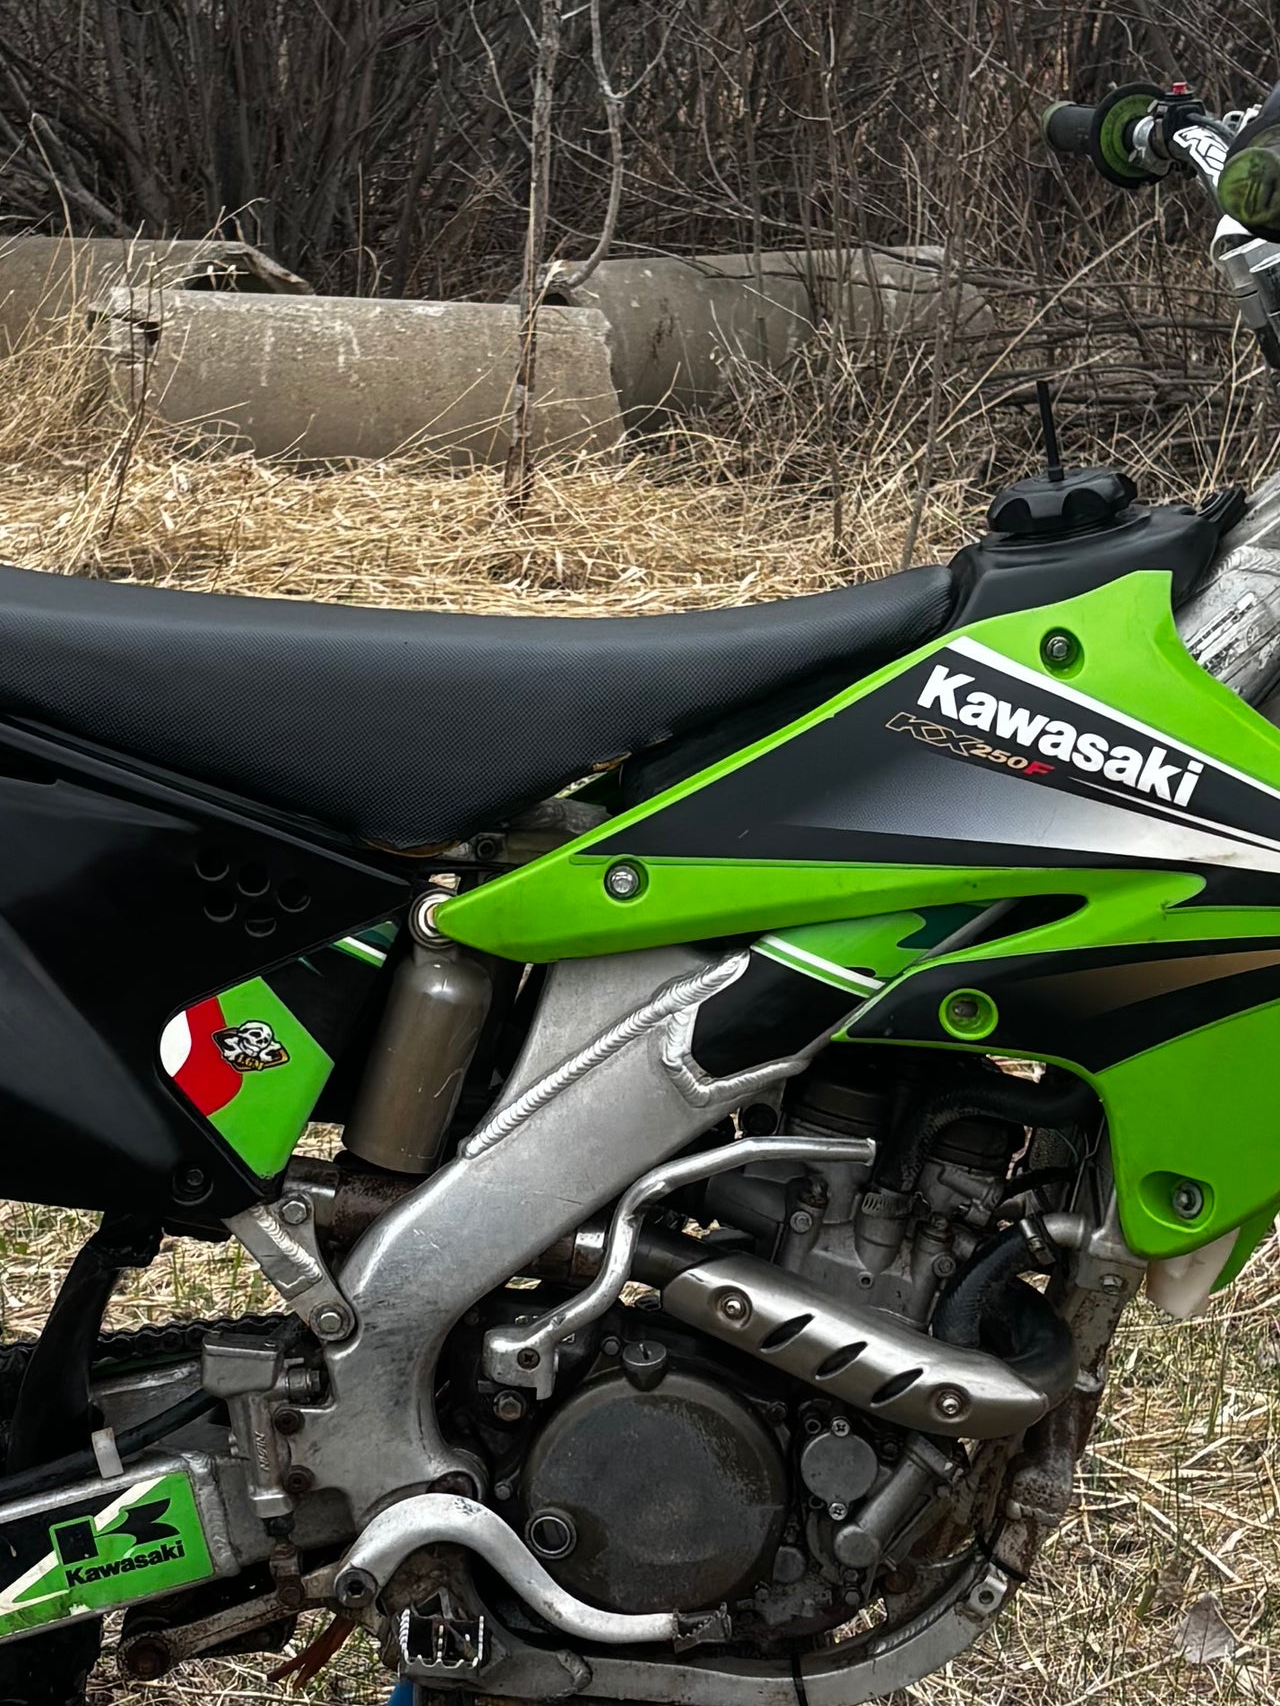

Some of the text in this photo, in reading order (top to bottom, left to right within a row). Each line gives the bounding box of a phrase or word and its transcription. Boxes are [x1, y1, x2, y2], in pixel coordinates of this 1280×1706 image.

[885, 711, 1056, 776] KX250F
[917, 664, 1204, 807] Kawasaki
[64, 1539, 186, 1589] Kawasaki
